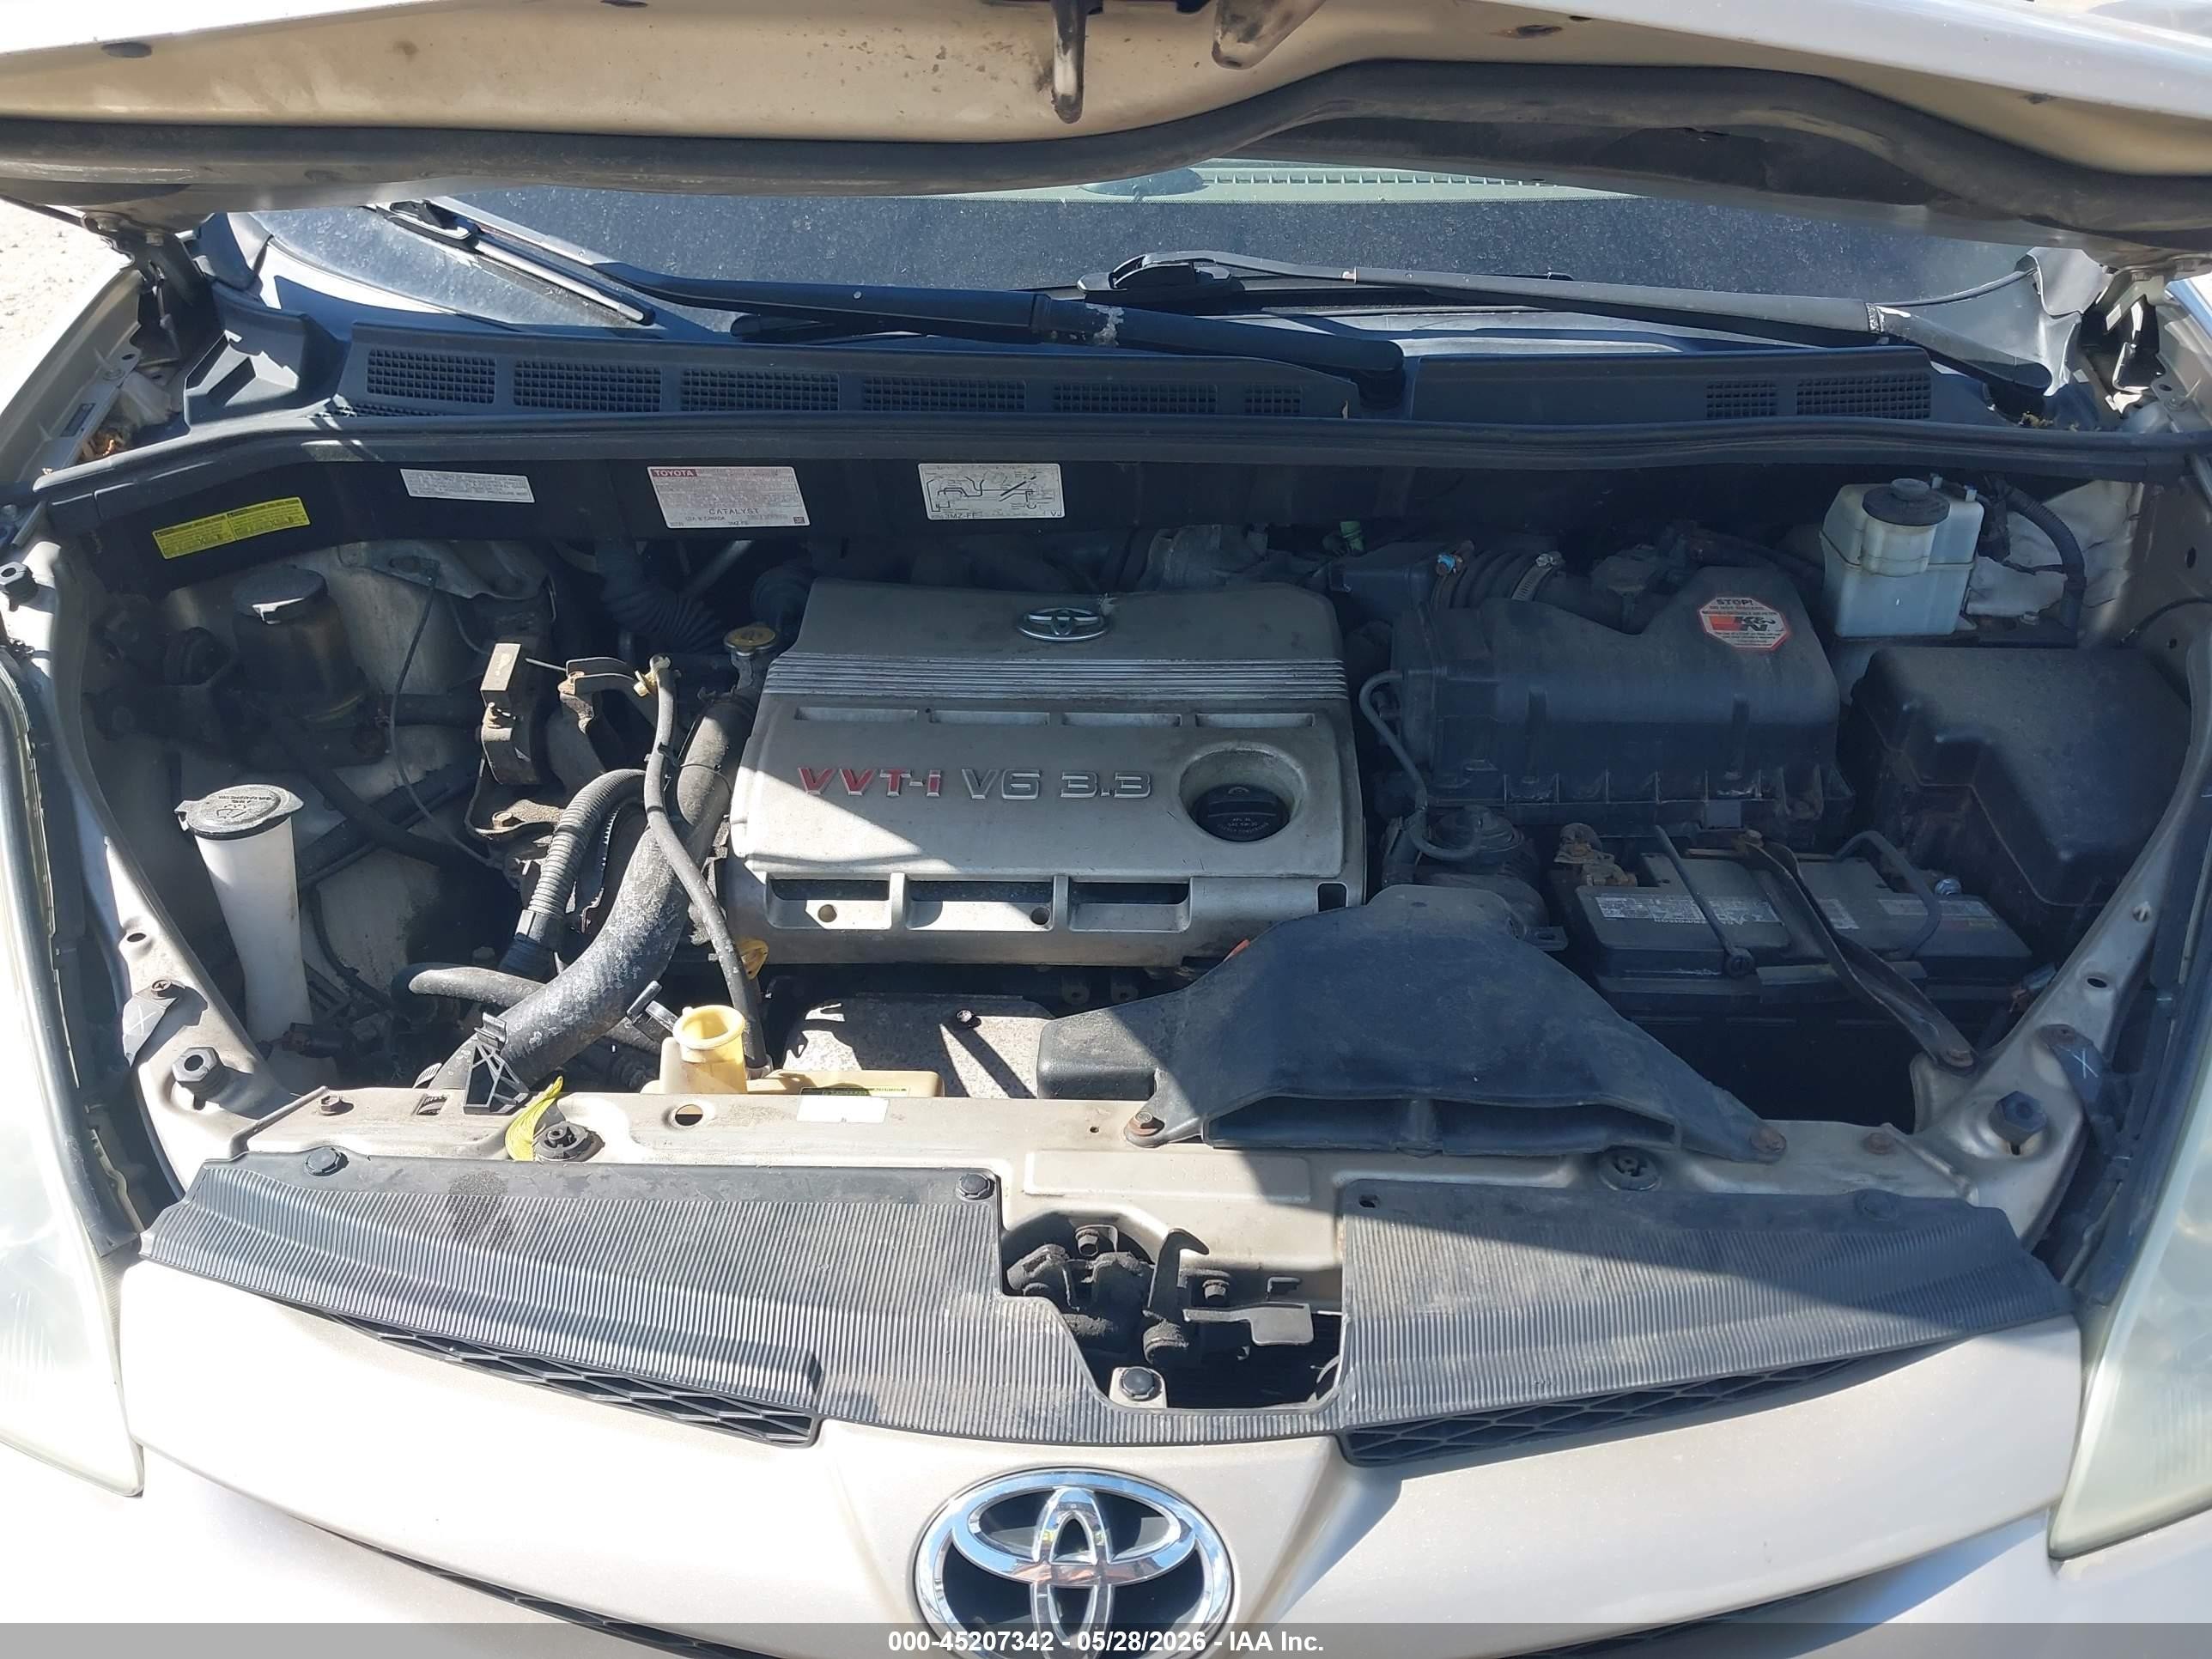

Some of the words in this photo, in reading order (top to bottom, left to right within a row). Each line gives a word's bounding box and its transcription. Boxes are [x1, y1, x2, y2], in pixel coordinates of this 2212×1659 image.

[797, 767, 942, 797] VVT-i
[961, 769, 1042, 800] V6
[1060, 770, 1152, 799] 3.3
